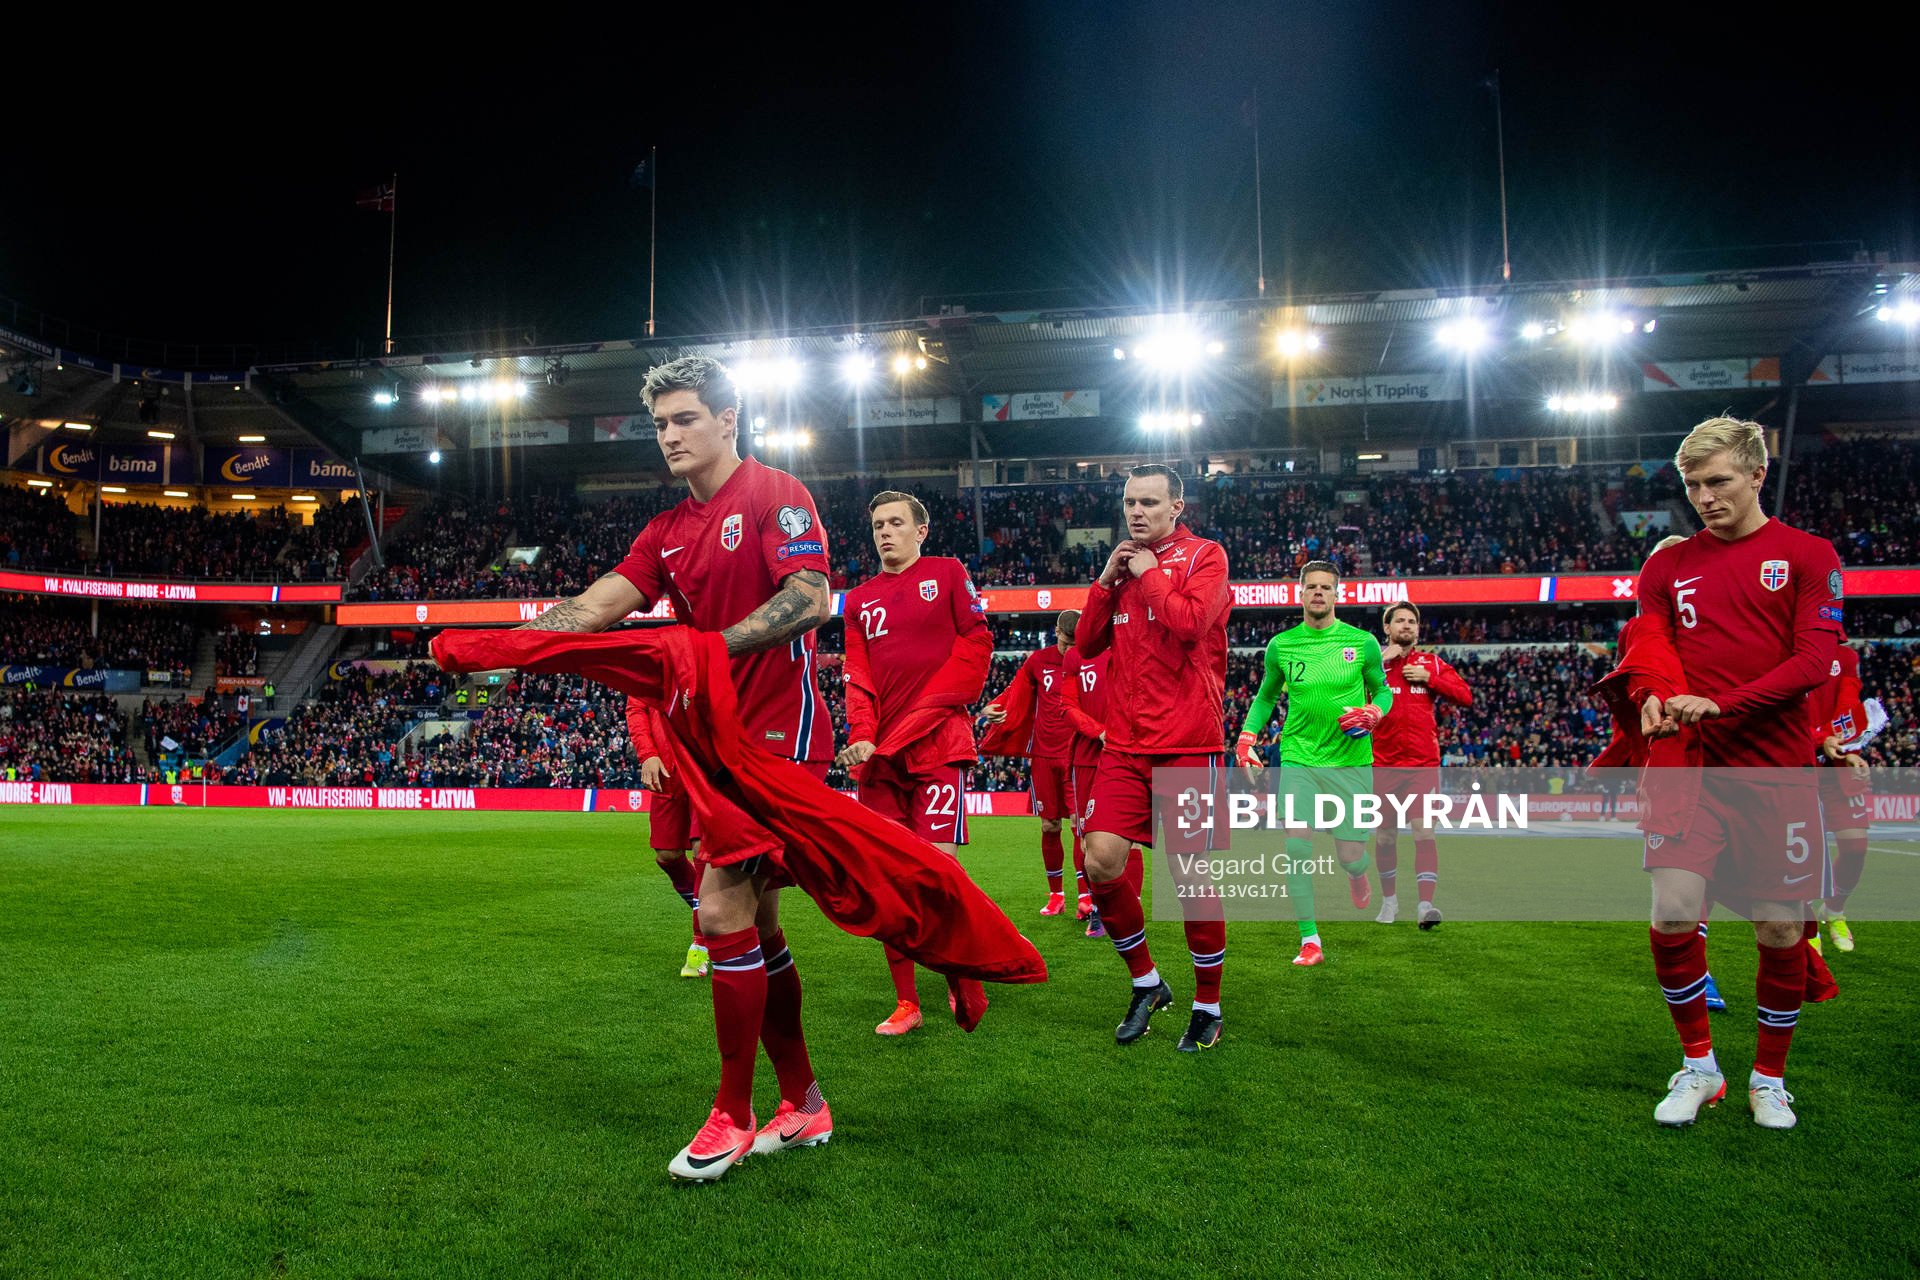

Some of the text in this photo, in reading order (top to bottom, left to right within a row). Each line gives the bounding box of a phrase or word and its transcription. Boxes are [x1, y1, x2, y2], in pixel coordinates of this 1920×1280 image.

[1331, 383, 1429, 400] Norsk Tipping
[908, 408, 938, 418] Tipping
[109, 455, 157, 473] bama
[789, 544, 822, 553] RESPECT
[44, 577, 123, 596] VM-KVALIFISERING
[1676, 588, 1697, 629] 5
[859, 606, 889, 641] 22
[75, 669, 109, 687] Bendit
[1079, 670, 1097, 692] 19
[1287, 661, 1306, 683] 12
[1043, 674, 1053, 692] 9
[268, 788, 373, 808] VM-KVALIFISERING
[925, 784, 956, 816] 22
[1528, 801, 1590, 813] EUROPEAN
[1785, 822, 1810, 864] 5
